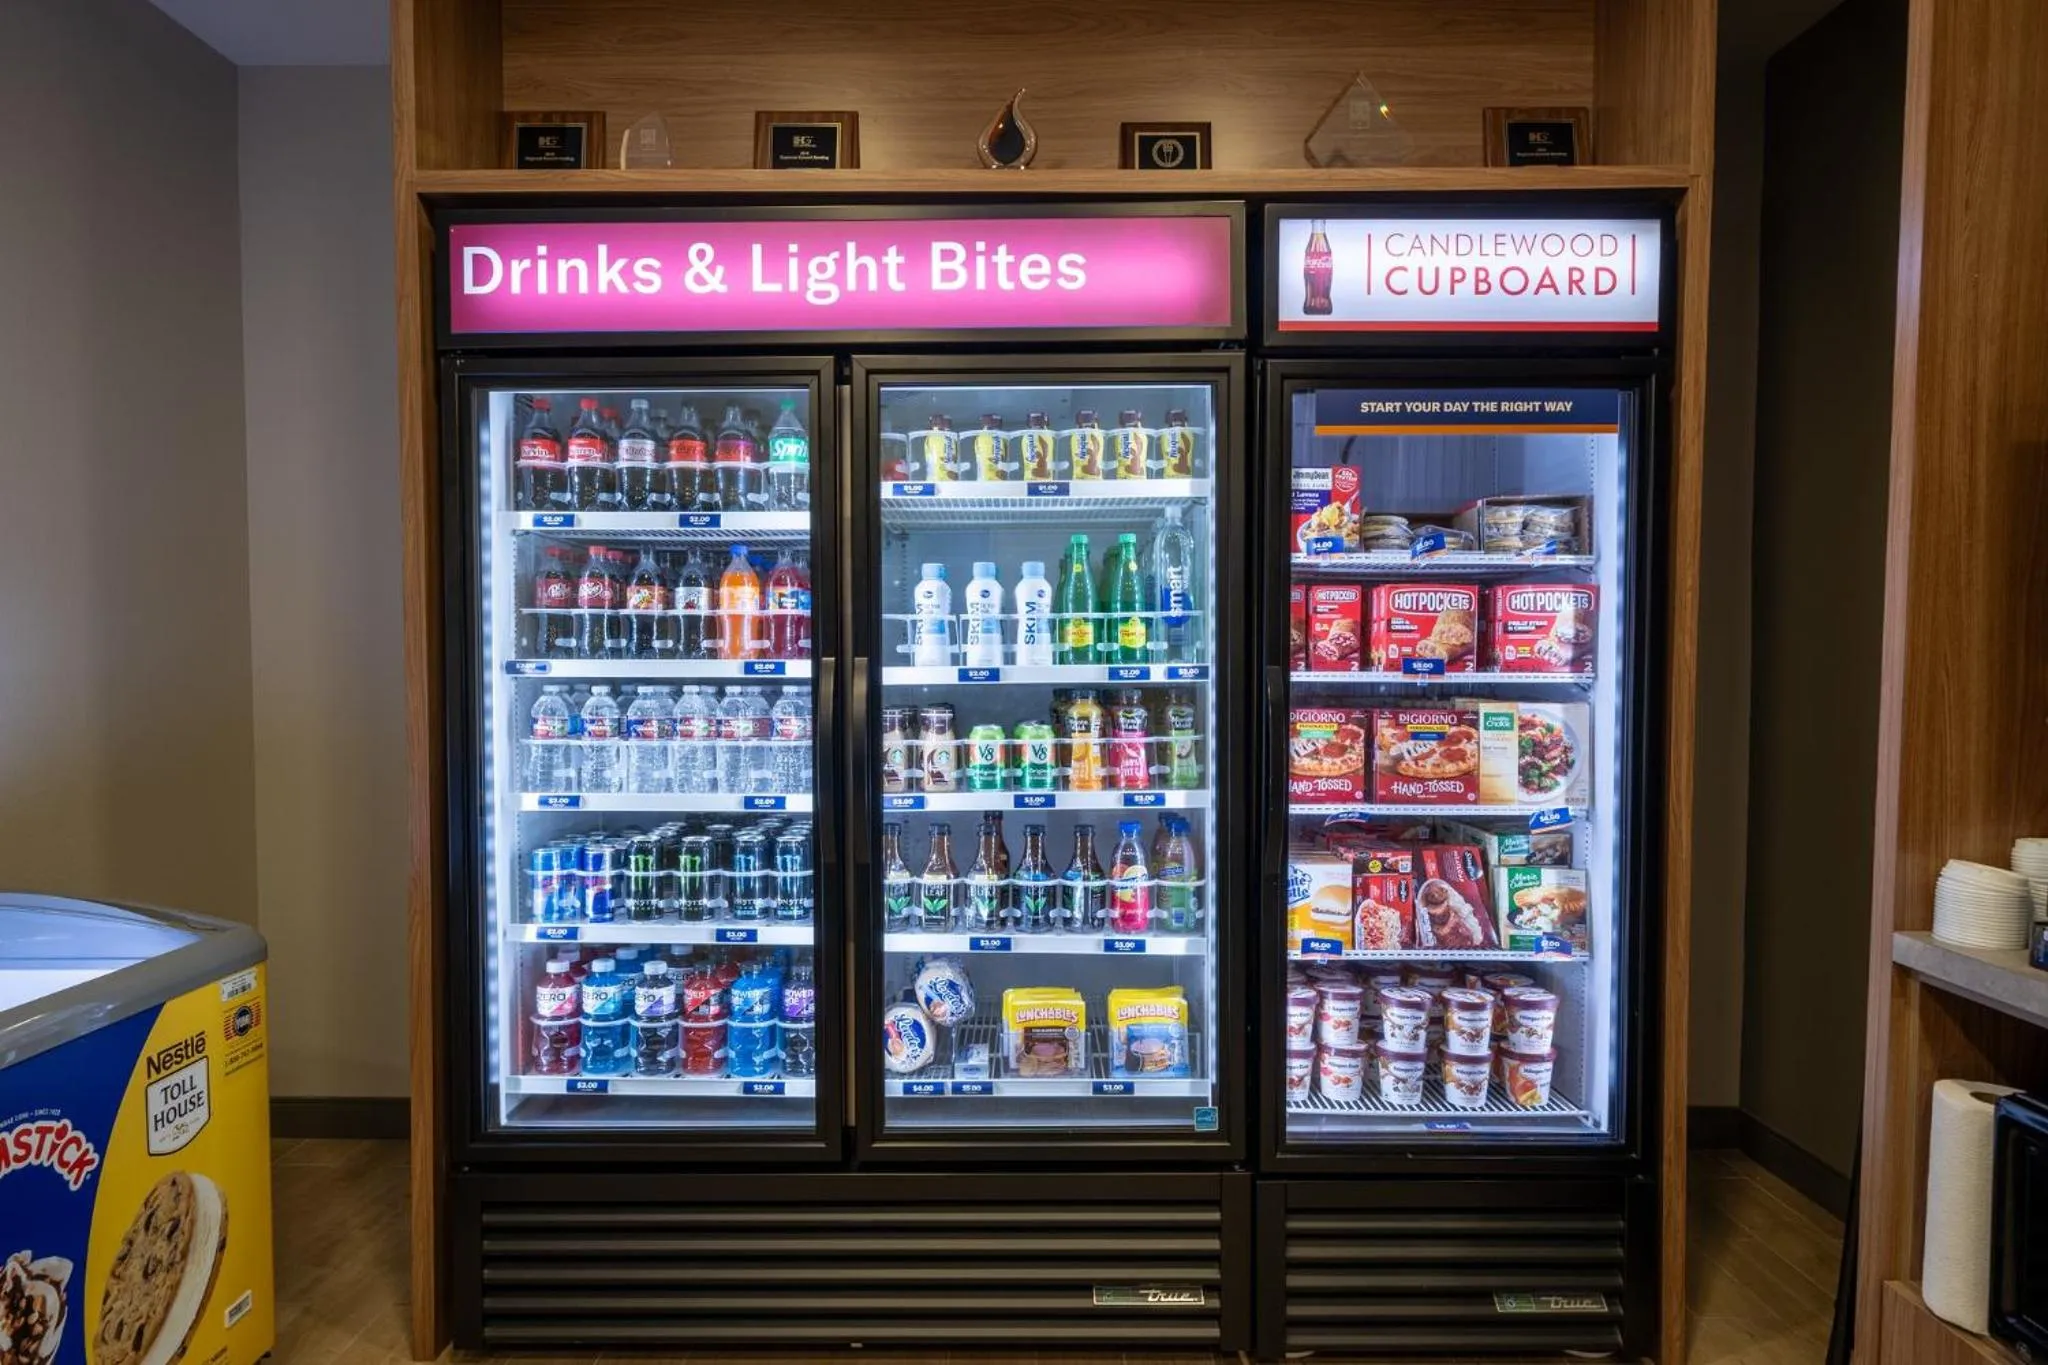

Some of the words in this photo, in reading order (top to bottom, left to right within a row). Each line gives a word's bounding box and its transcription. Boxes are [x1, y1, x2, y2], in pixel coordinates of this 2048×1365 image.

[1385, 233, 1618, 257] CANDLEWOOD
[463, 244, 662, 294] Drinks
[684, 242, 728, 294] &
[751, 242, 906, 305] Light
[931, 242, 1087, 291] Bites
[1385, 266, 1617, 296] CUPBOARD
[1360, 402, 1402, 413] START
[1404, 402, 1441, 413] YOUR
[1443, 401, 1469, 412] DAY
[1472, 401, 1498, 412] THE
[1501, 401, 1541, 412] RIGHT
[1544, 401, 1573, 412] WAY
[1169, 566, 1183, 617] smart
[1024, 601, 1037, 645] SKIM
[1351, 661, 1359, 671] 2
[1465, 661, 1473, 671] 2
[1584, 661, 1593, 671] 2
[978, 744, 995, 762] V8
[1031, 744, 1048, 762] V8
[1391, 780, 1464, 795] HAND-TOSSED
[1015, 1007, 1079, 1024] LUNCHABLES
[1117, 1003, 1181, 1021] LUNCHABLES
[161, 1075, 198, 1106] TOLL
[153, 1092, 206, 1133] HOUSE
